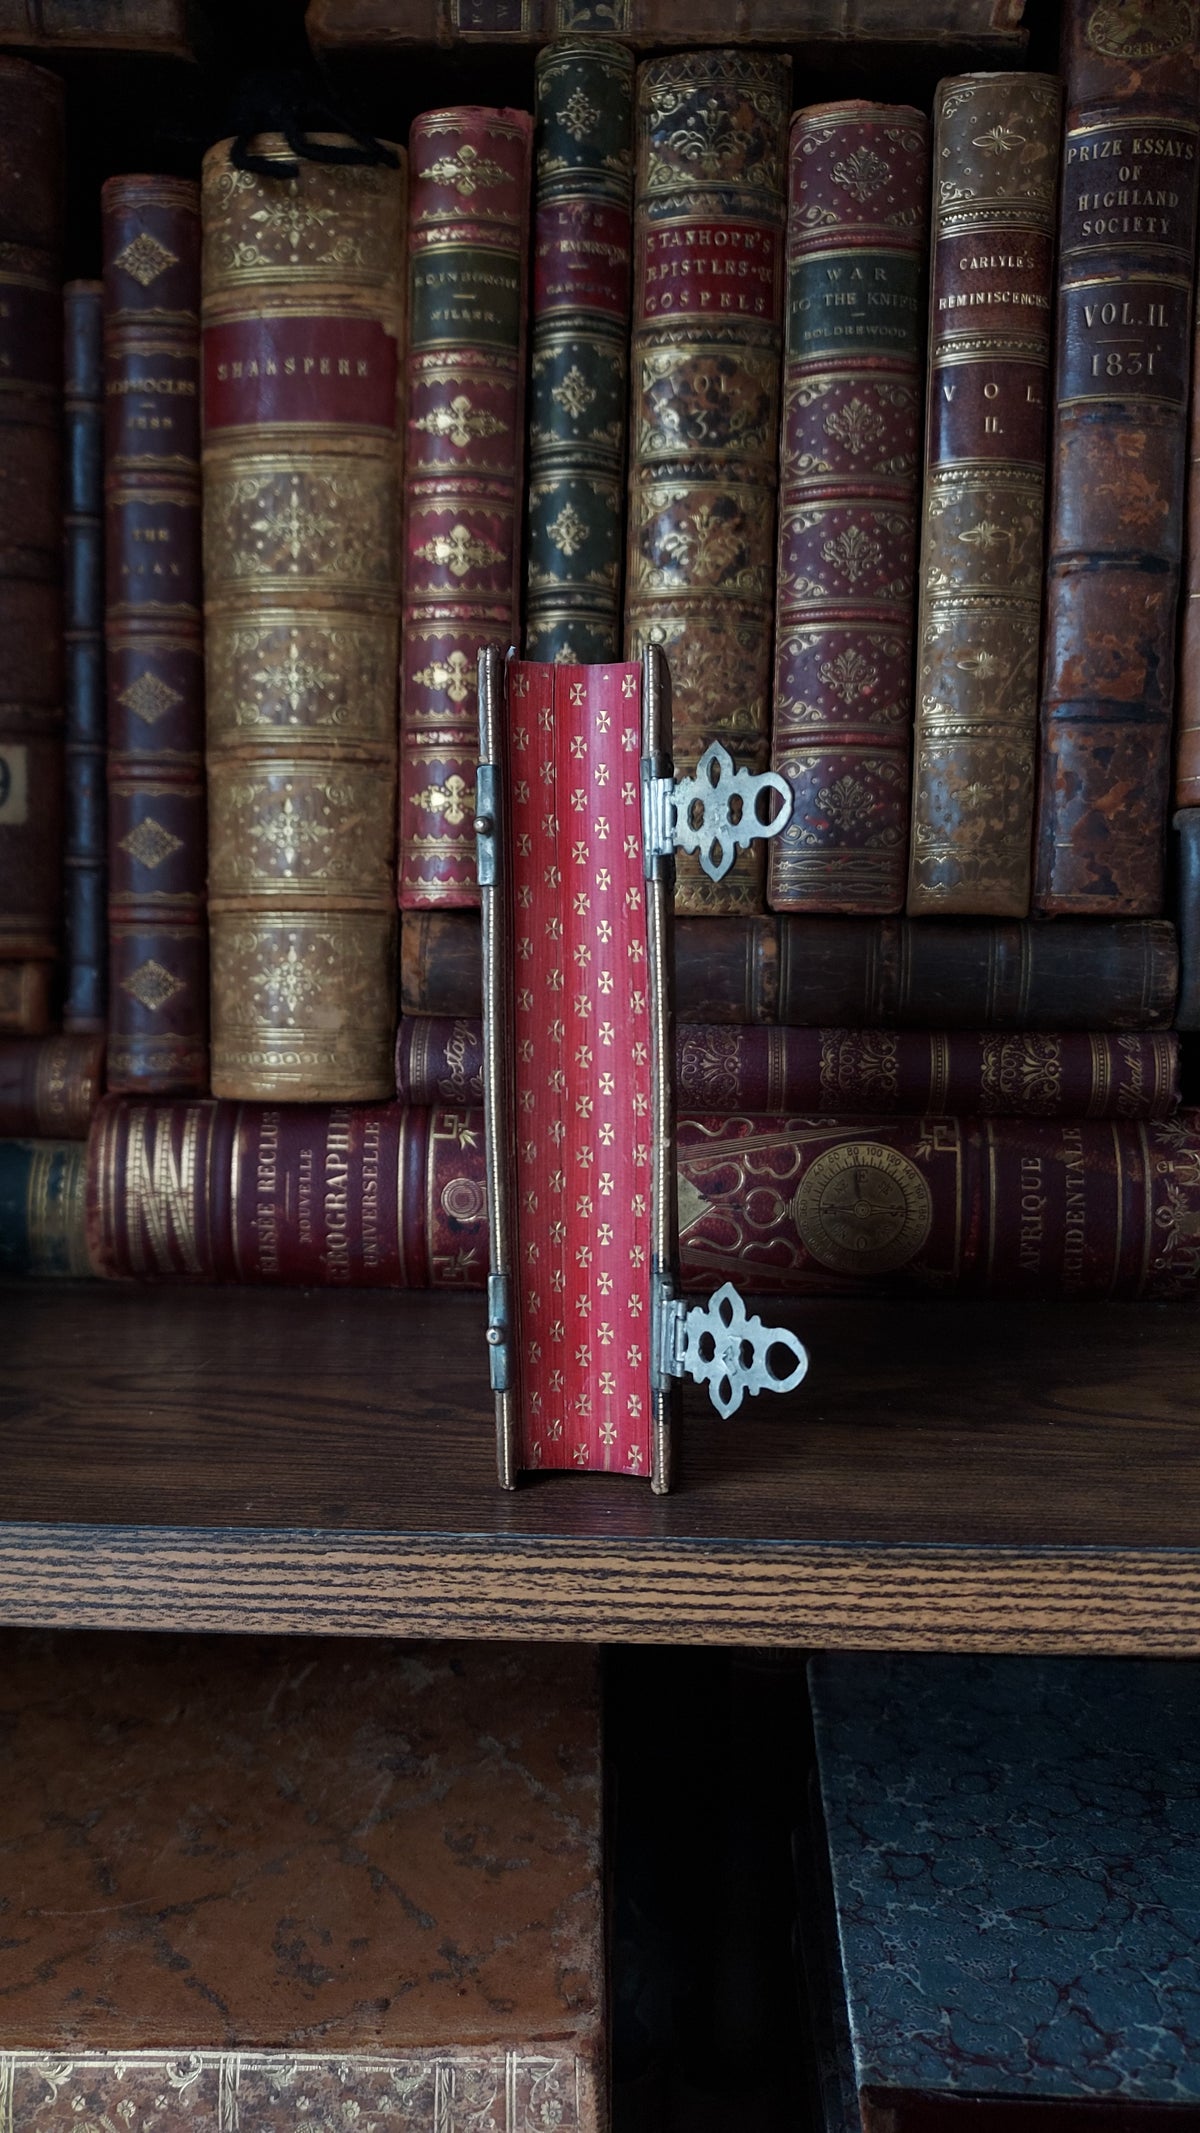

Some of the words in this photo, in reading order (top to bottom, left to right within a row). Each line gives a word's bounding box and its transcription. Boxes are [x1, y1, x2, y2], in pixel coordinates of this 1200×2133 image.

[1067, 139, 1123, 165] PRIZE
[1132, 138, 1194, 160] ESSAYS
[1118, 166, 1142, 182] OF
[1078, 190, 1179, 212] HIGHLAND
[1081, 216, 1171, 237] SOCIETY
[959, 250, 1036, 271] CARLYLE'S
[826, 267, 888, 281] WAR
[645, 289, 765, 312] GOSPELS
[793, 296, 812, 313] TO
[823, 292, 857, 306] THE
[867, 292, 919, 312] KNIFE
[804, 326, 907, 341] BOLDREWOOD
[1091, 352, 1155, 377] 1831
[437, 1019, 477, 1103] Postage
[256, 1110, 280, 1194] RECLUS
[298, 1148, 313, 1244] NOUVELLE
[361, 1120, 381, 1268] UNIVERSELLE
[1018, 1156, 1048, 1279] AFRIQUE
